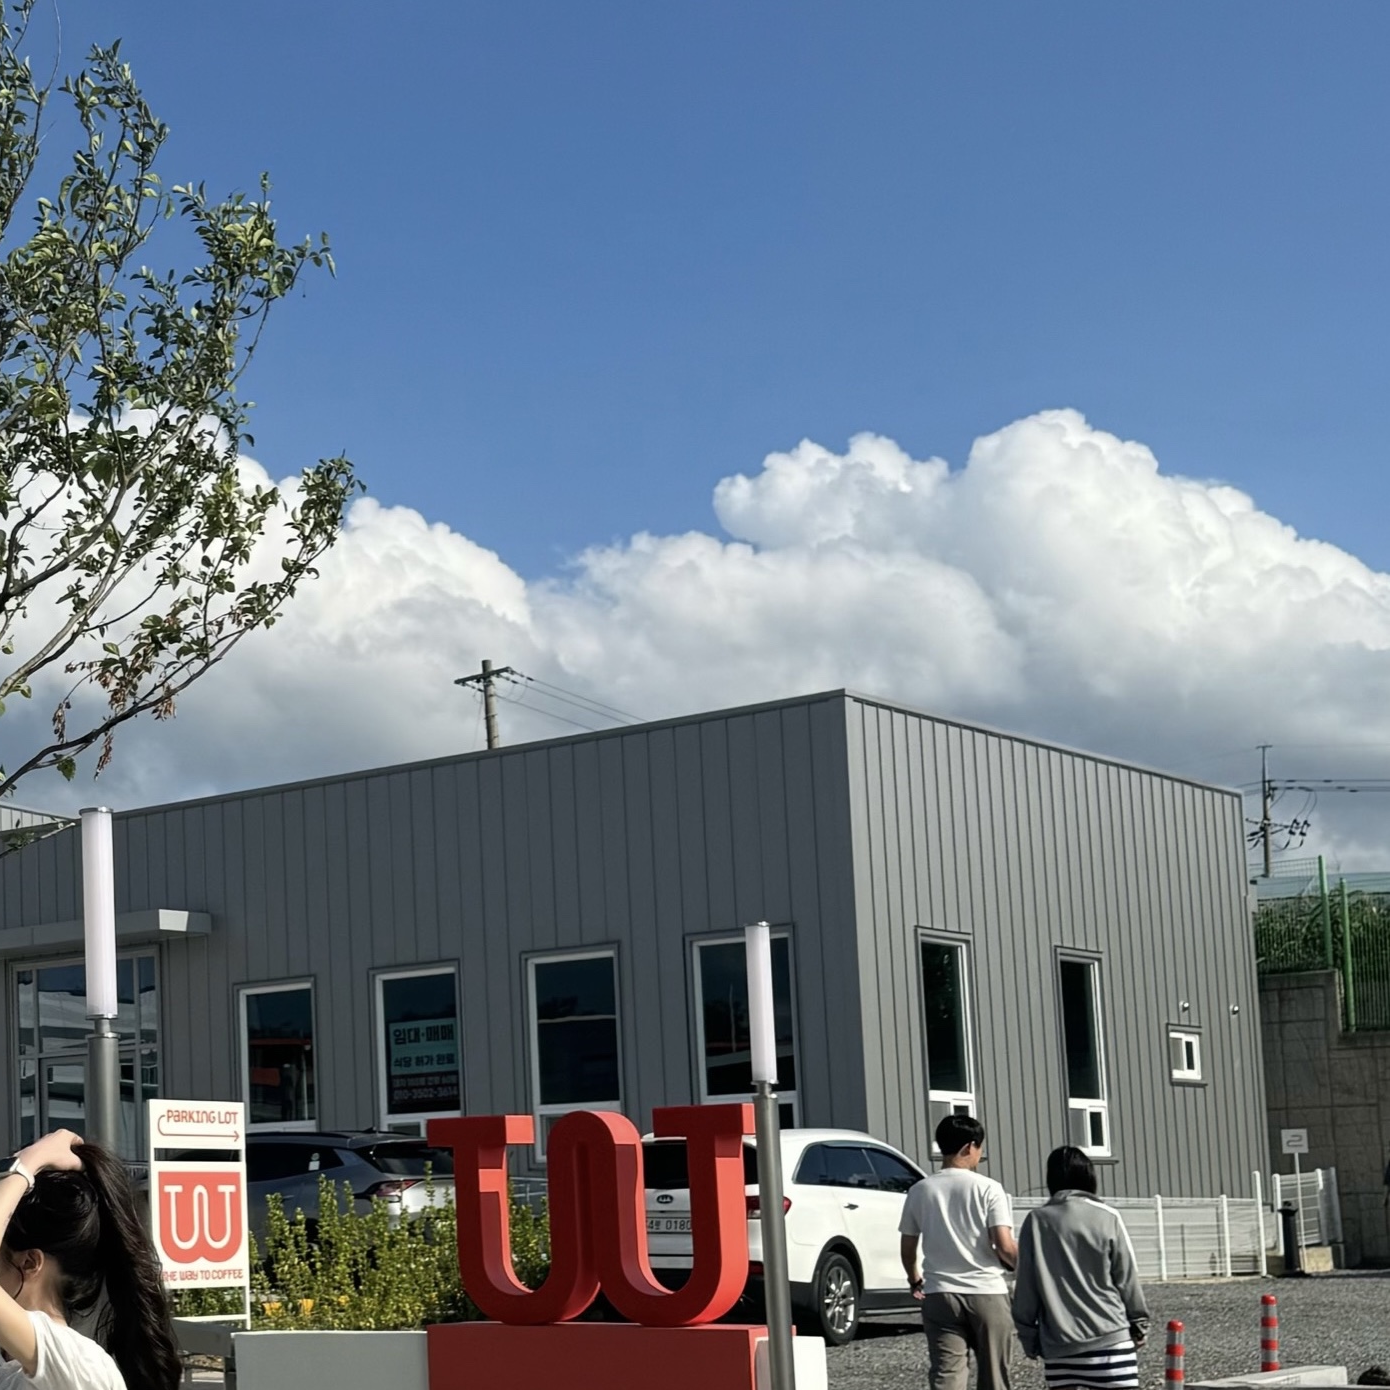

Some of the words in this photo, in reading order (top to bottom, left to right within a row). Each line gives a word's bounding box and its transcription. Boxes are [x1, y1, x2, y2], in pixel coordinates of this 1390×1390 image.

[218, 1111, 238, 1125] LOT
[164, 1184, 237, 1250] W
[200, 1269, 211, 1280] TO
[211, 1268, 243, 1280] COFFEE
